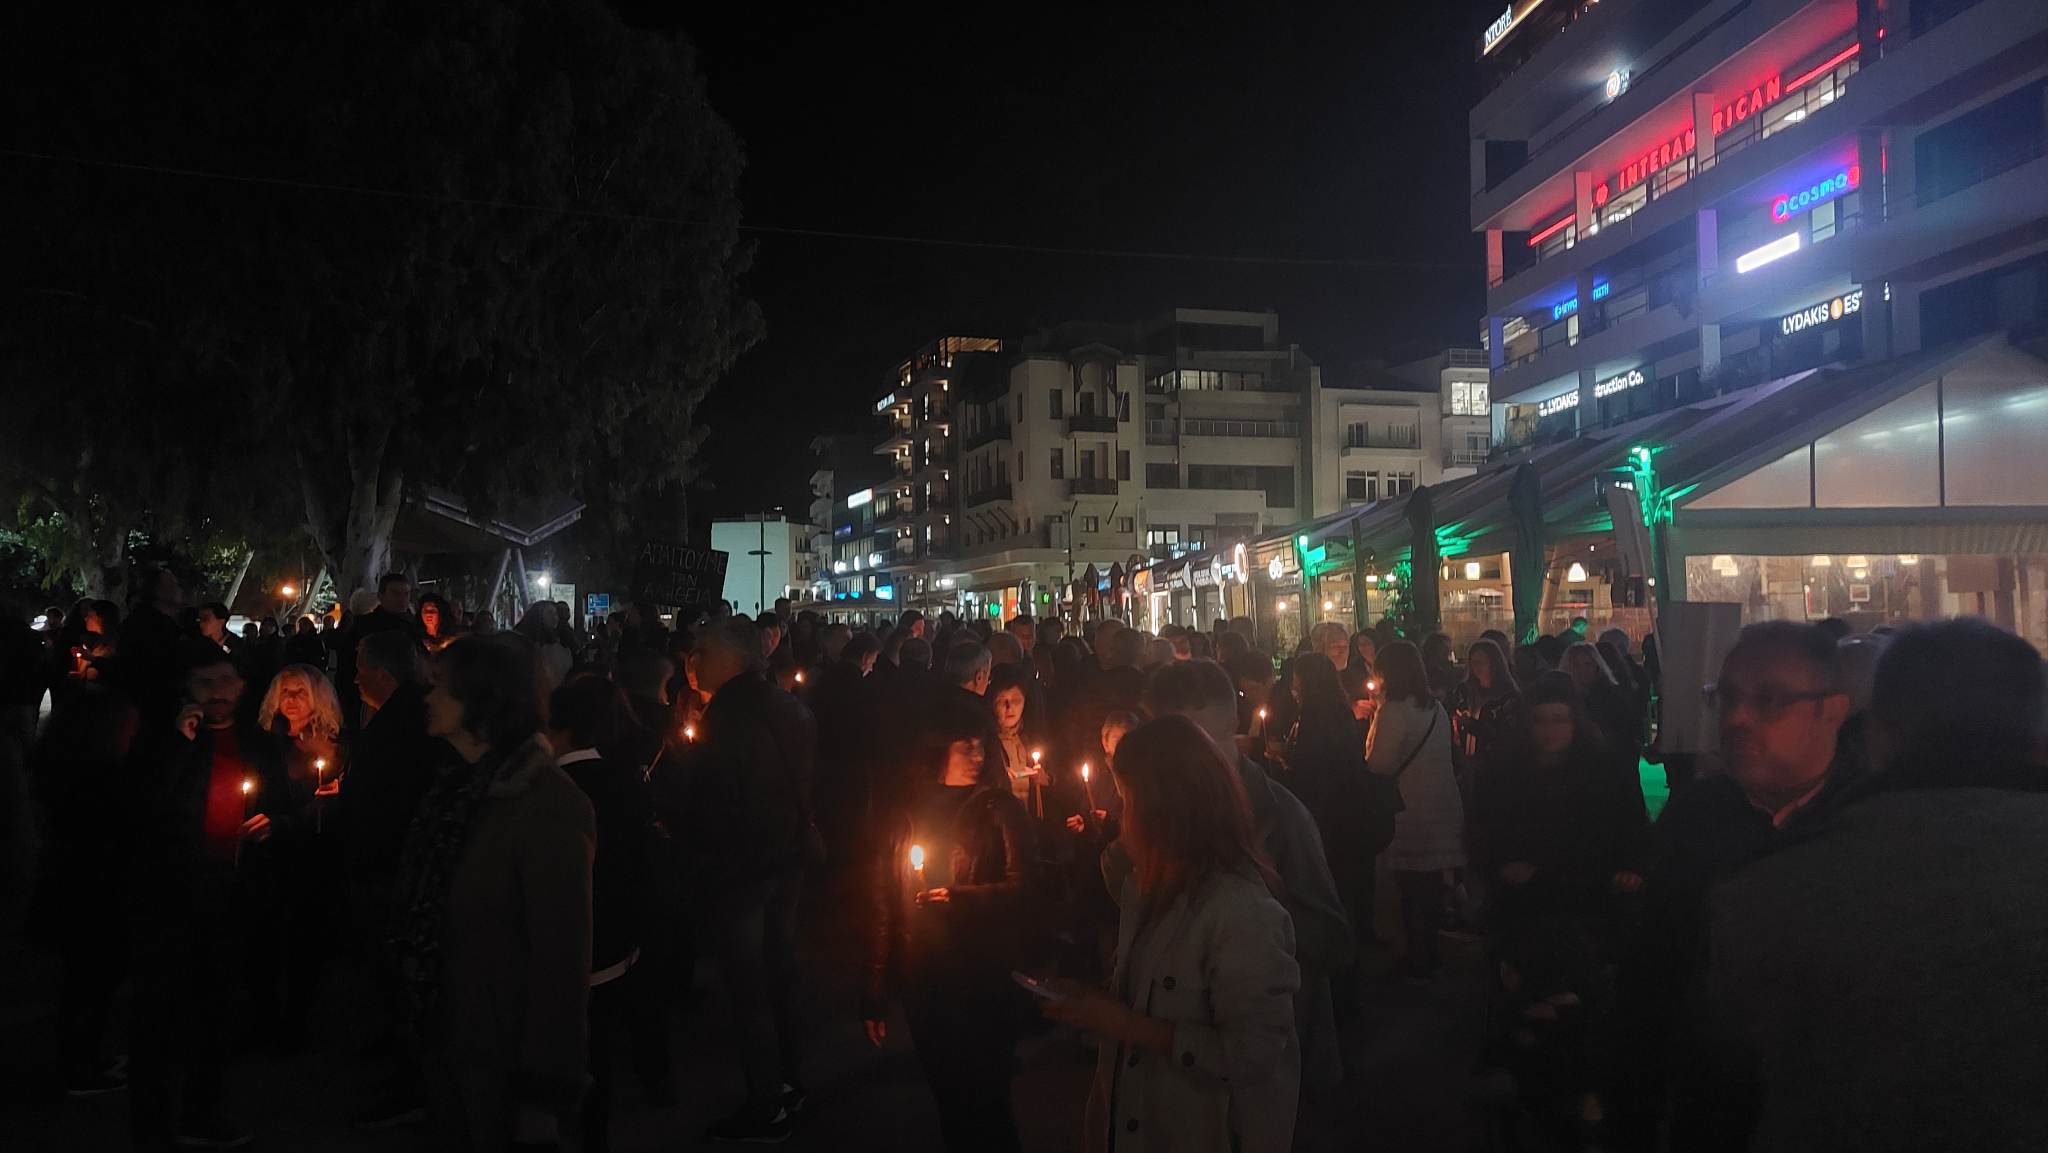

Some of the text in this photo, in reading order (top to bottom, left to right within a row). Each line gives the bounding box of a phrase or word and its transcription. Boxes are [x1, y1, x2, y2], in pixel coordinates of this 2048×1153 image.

[1619, 75, 1781, 192] INTERAMRICAN
[1783, 303, 1829, 335] LYDAKIS
[1547, 390, 1579, 415] LYDAKIS
[1628, 370, 1644, 387] Co.
